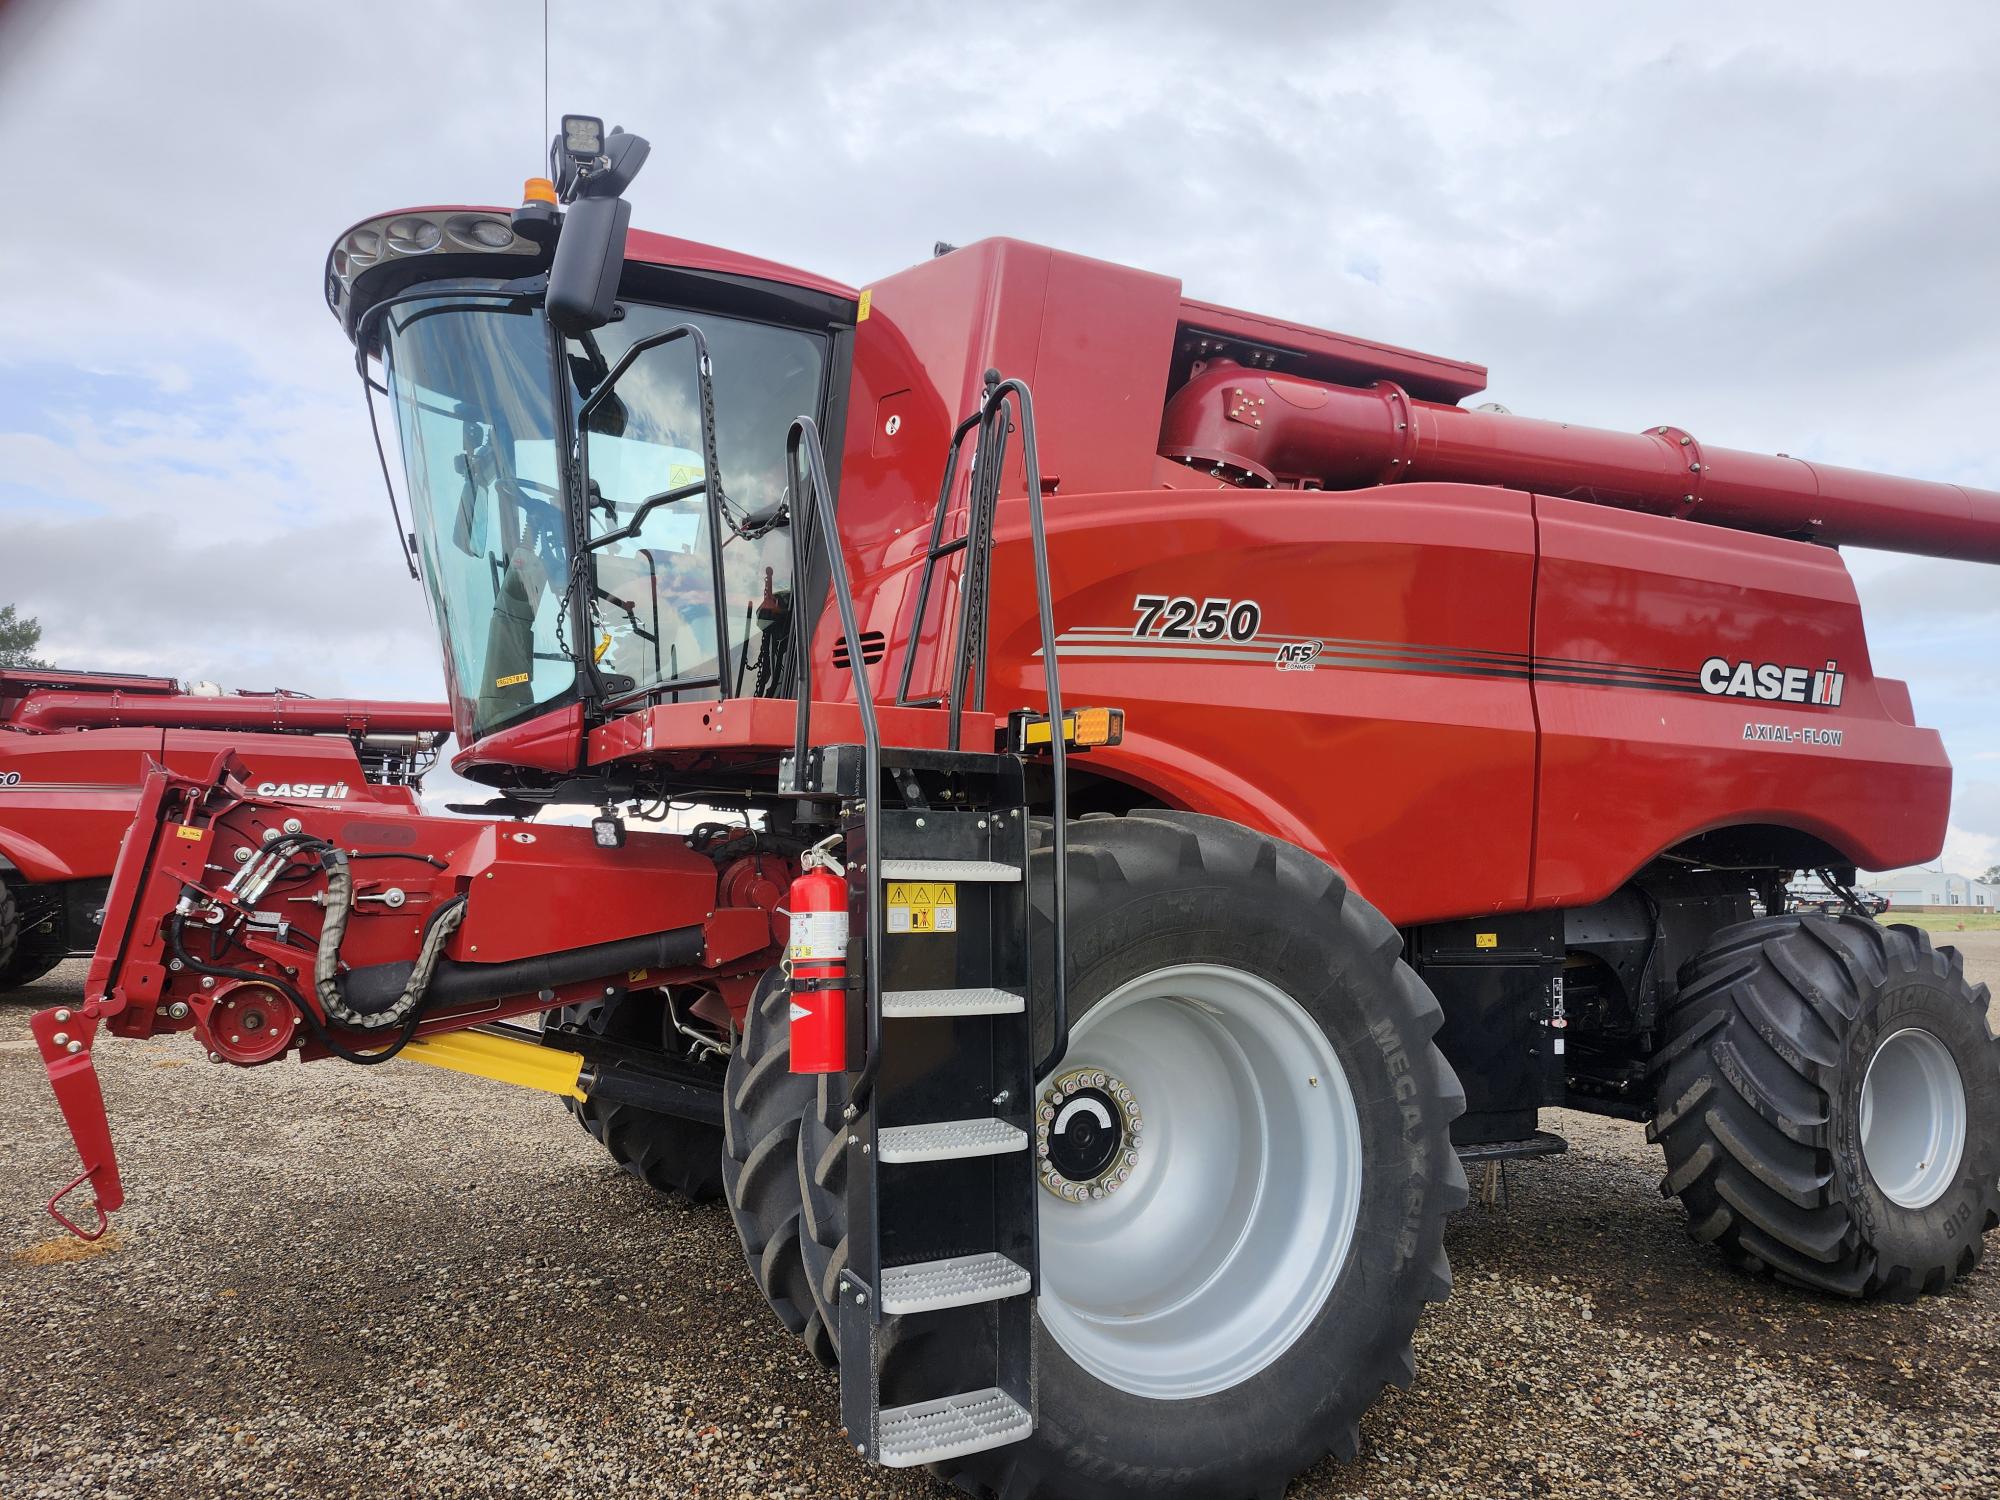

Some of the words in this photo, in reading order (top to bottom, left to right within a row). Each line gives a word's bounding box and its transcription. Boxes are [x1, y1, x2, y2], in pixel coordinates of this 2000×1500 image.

[1132, 594, 1262, 644] 7250
[1276, 641, 1314, 663] AFS
[1285, 662, 1316, 673] CONNECT
[1700, 657, 1809, 703] CASE
[1811, 660, 1845, 706] IH
[1743, 723, 1843, 746] AXIAL-FLOW
[257, 782, 326, 798] CASE
